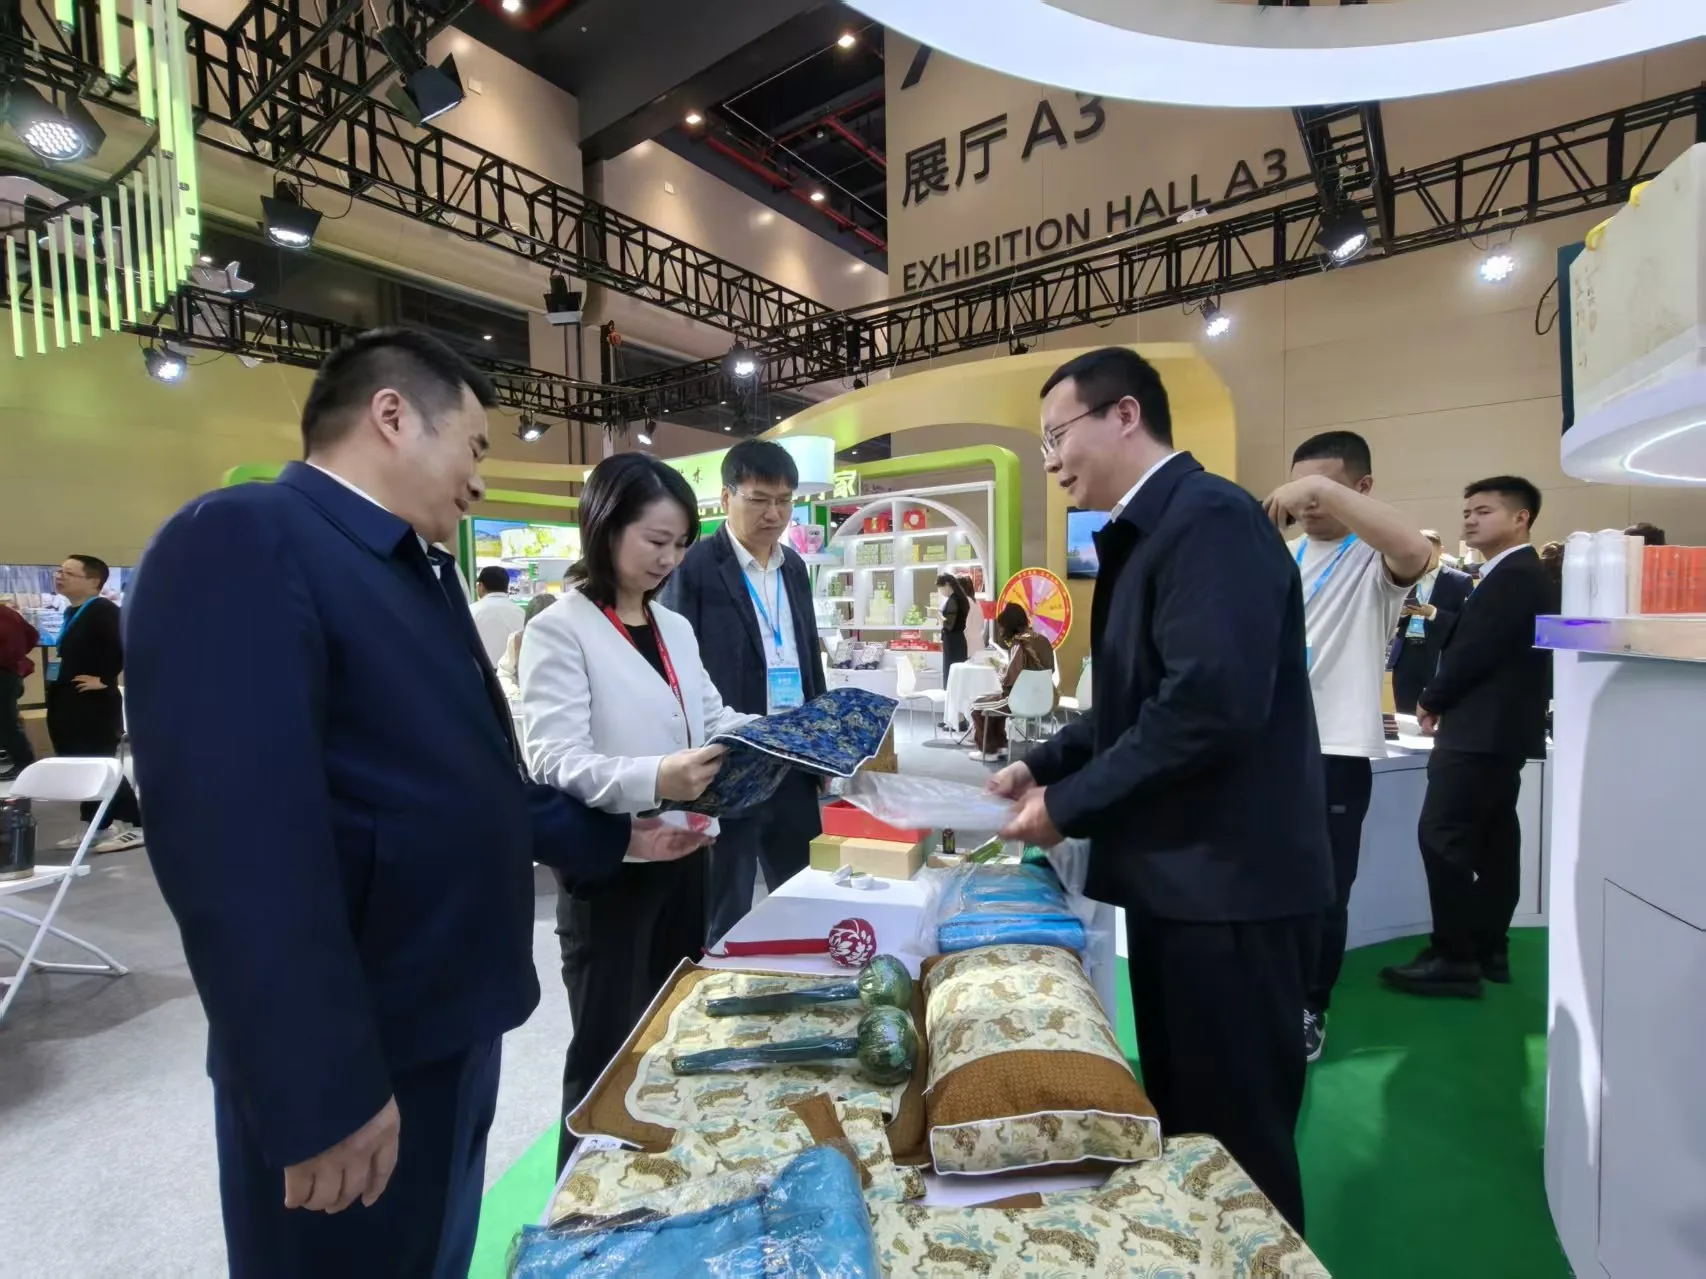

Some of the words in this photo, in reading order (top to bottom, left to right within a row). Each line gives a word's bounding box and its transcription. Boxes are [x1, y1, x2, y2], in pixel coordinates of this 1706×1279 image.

[902, 113, 1007, 207] 展厅
[903, 207, 1090, 293] EXHIBITION
[1106, 174, 1211, 233] HALL
[1224, 148, 1288, 200] A3
